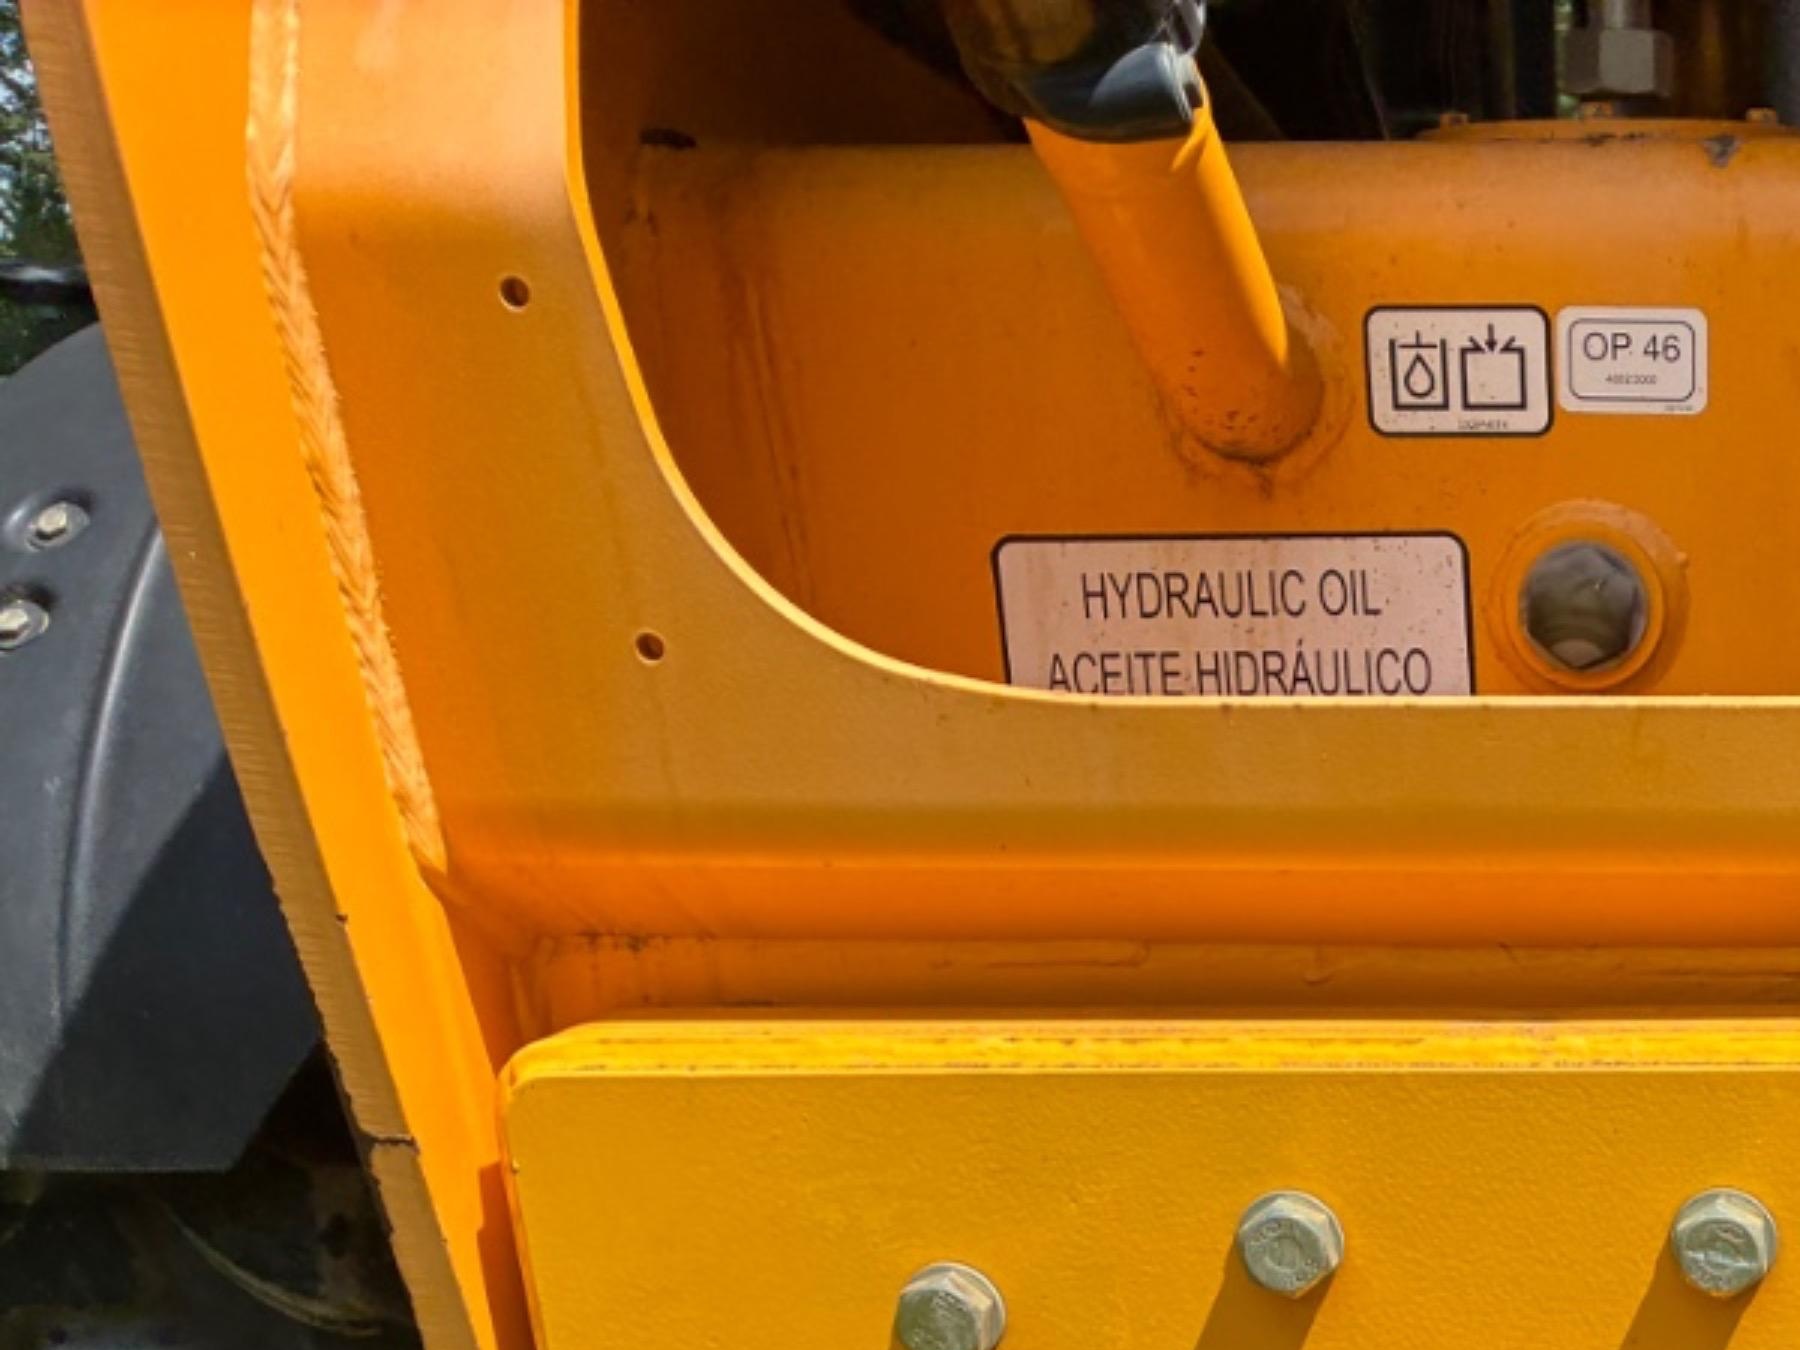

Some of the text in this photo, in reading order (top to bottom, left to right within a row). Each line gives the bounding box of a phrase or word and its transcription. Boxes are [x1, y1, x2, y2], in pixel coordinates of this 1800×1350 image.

[1583, 332, 1681, 363] OP 46
[1081, 569, 1382, 621] HYDRAULIC OIL
[1048, 636, 1432, 696] ACEITE HIDRÁULICO
